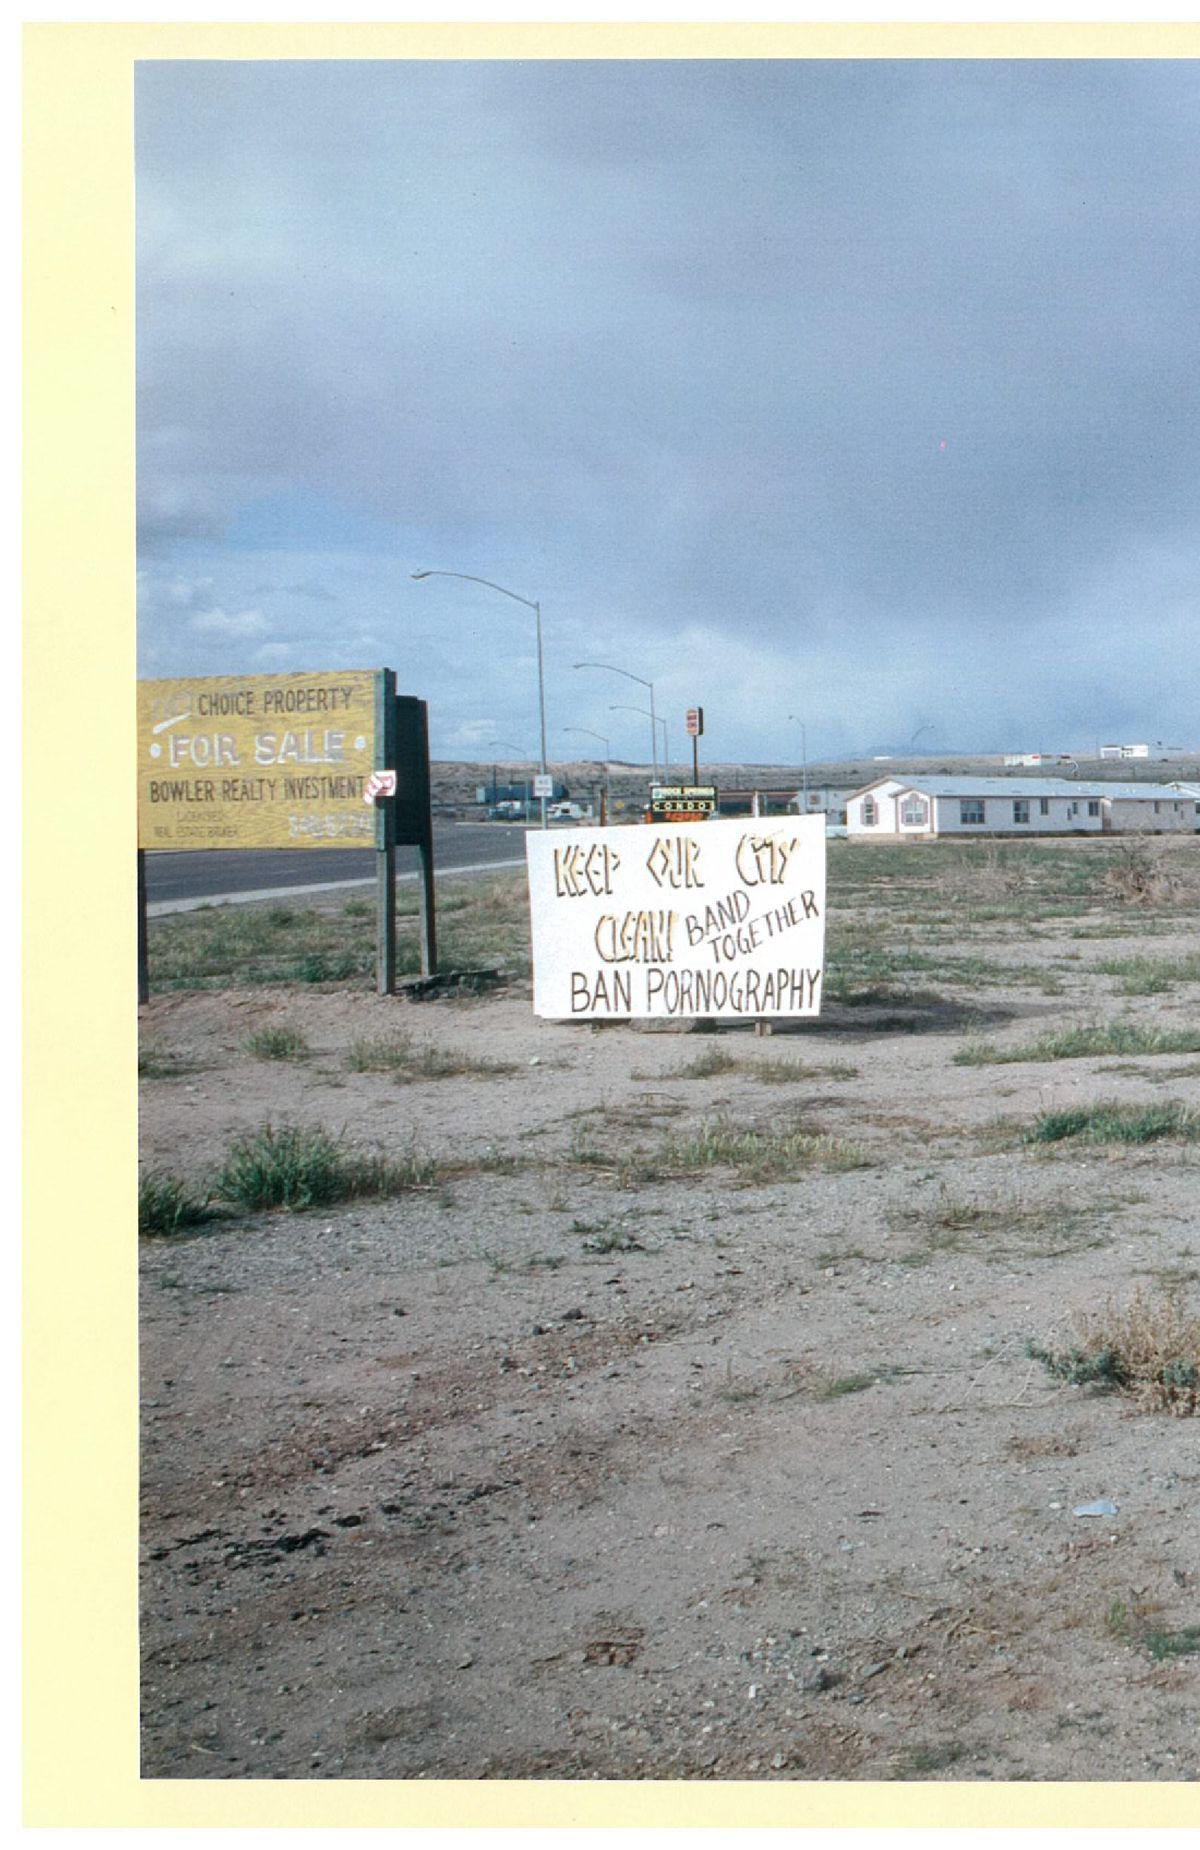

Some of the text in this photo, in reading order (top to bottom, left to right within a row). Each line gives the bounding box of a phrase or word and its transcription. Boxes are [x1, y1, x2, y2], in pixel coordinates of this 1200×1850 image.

[199, 691, 254, 716] CHOICE
[264, 686, 353, 714] PROPERTY
[169, 729, 346, 768] FOR SALE
[150, 780, 214, 803] BOWLER
[222, 778, 278, 801] REALTY
[554, 843, 621, 897] KEEP
[646, 836, 705, 889] OUR
[685, 890, 751, 946] BAND
[707, 890, 820, 963] TOGETHER
[570, 968, 822, 1014] BAN PORNOGRAPHY
